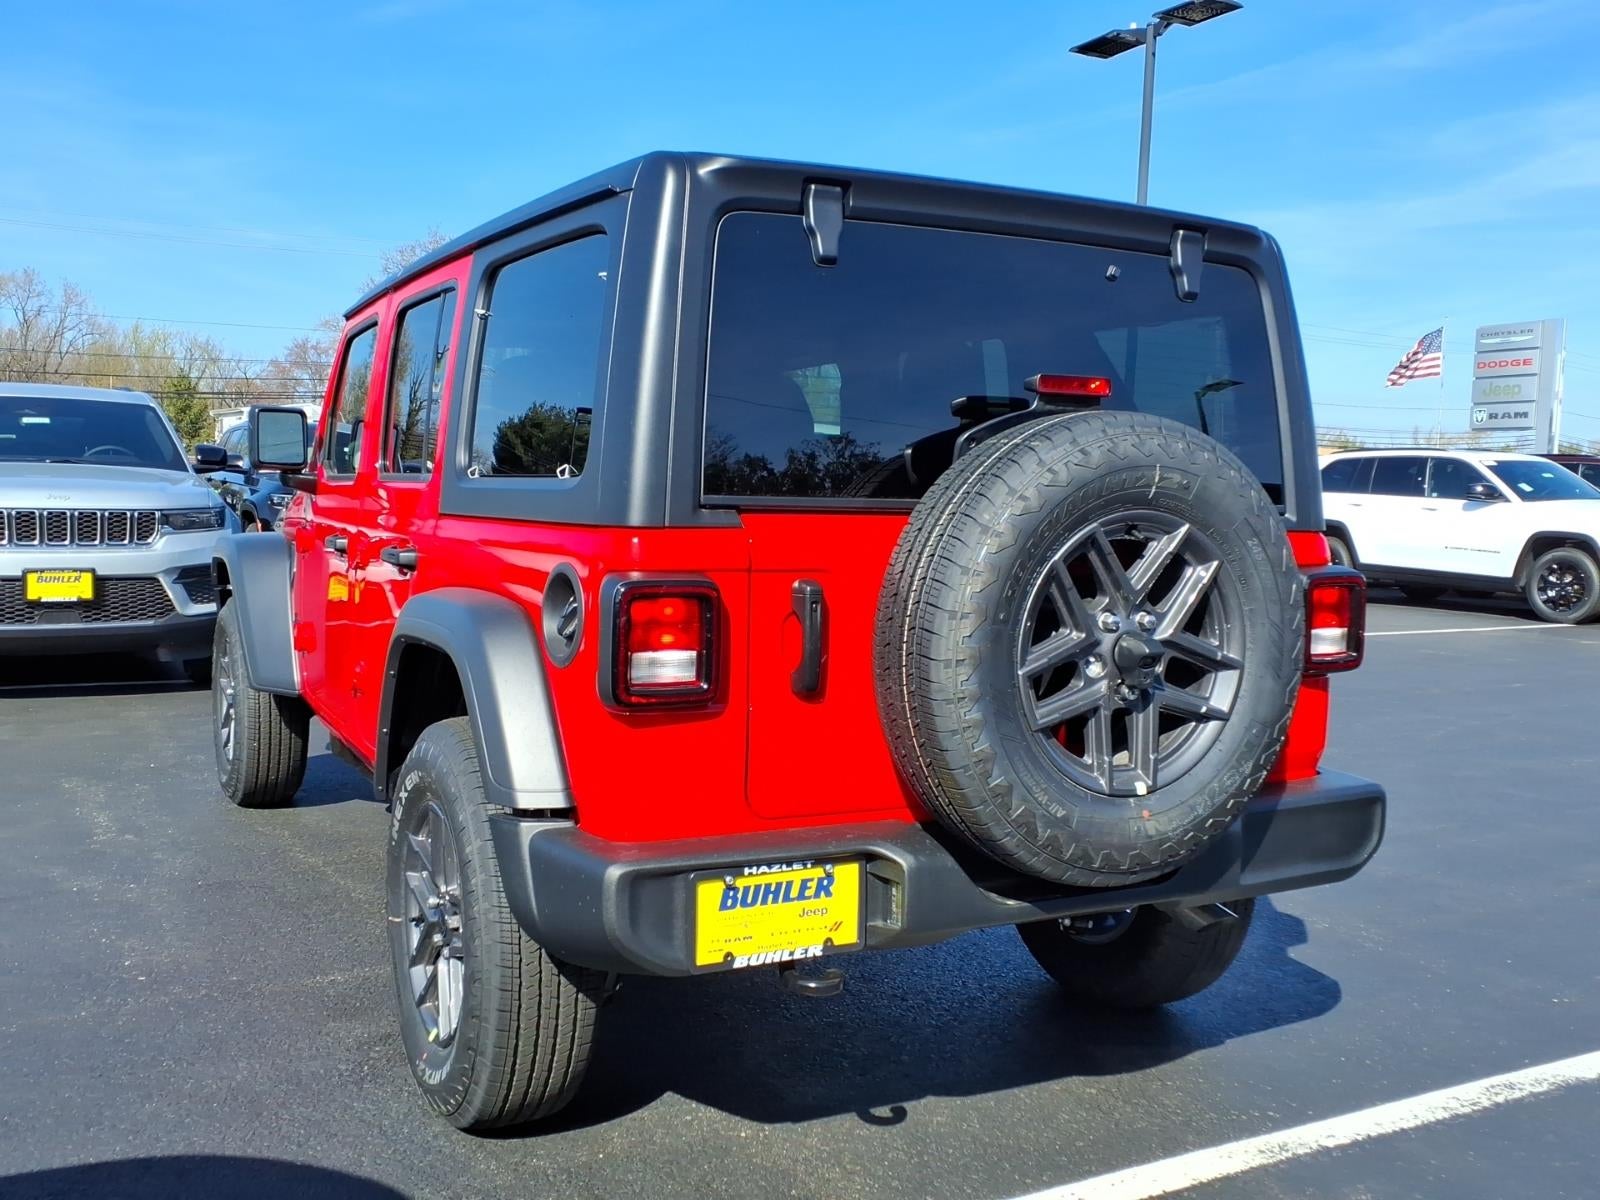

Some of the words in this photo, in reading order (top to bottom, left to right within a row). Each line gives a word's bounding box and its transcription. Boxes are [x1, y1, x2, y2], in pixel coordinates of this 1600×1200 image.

[1480, 328, 1534, 338] CHRYSLER
[1476, 358, 1533, 369] DODGE
[1482, 381, 1522, 398] Jeep
[1488, 411, 1529, 420] RAM
[36, 575, 82, 584] BUHLER
[391, 769, 420, 842] NEXEN
[745, 861, 814, 875] HAZLET
[719, 876, 834, 910] BUHLER
[798, 906, 828, 919] Jeep
[732, 944, 824, 969] BUHLER
